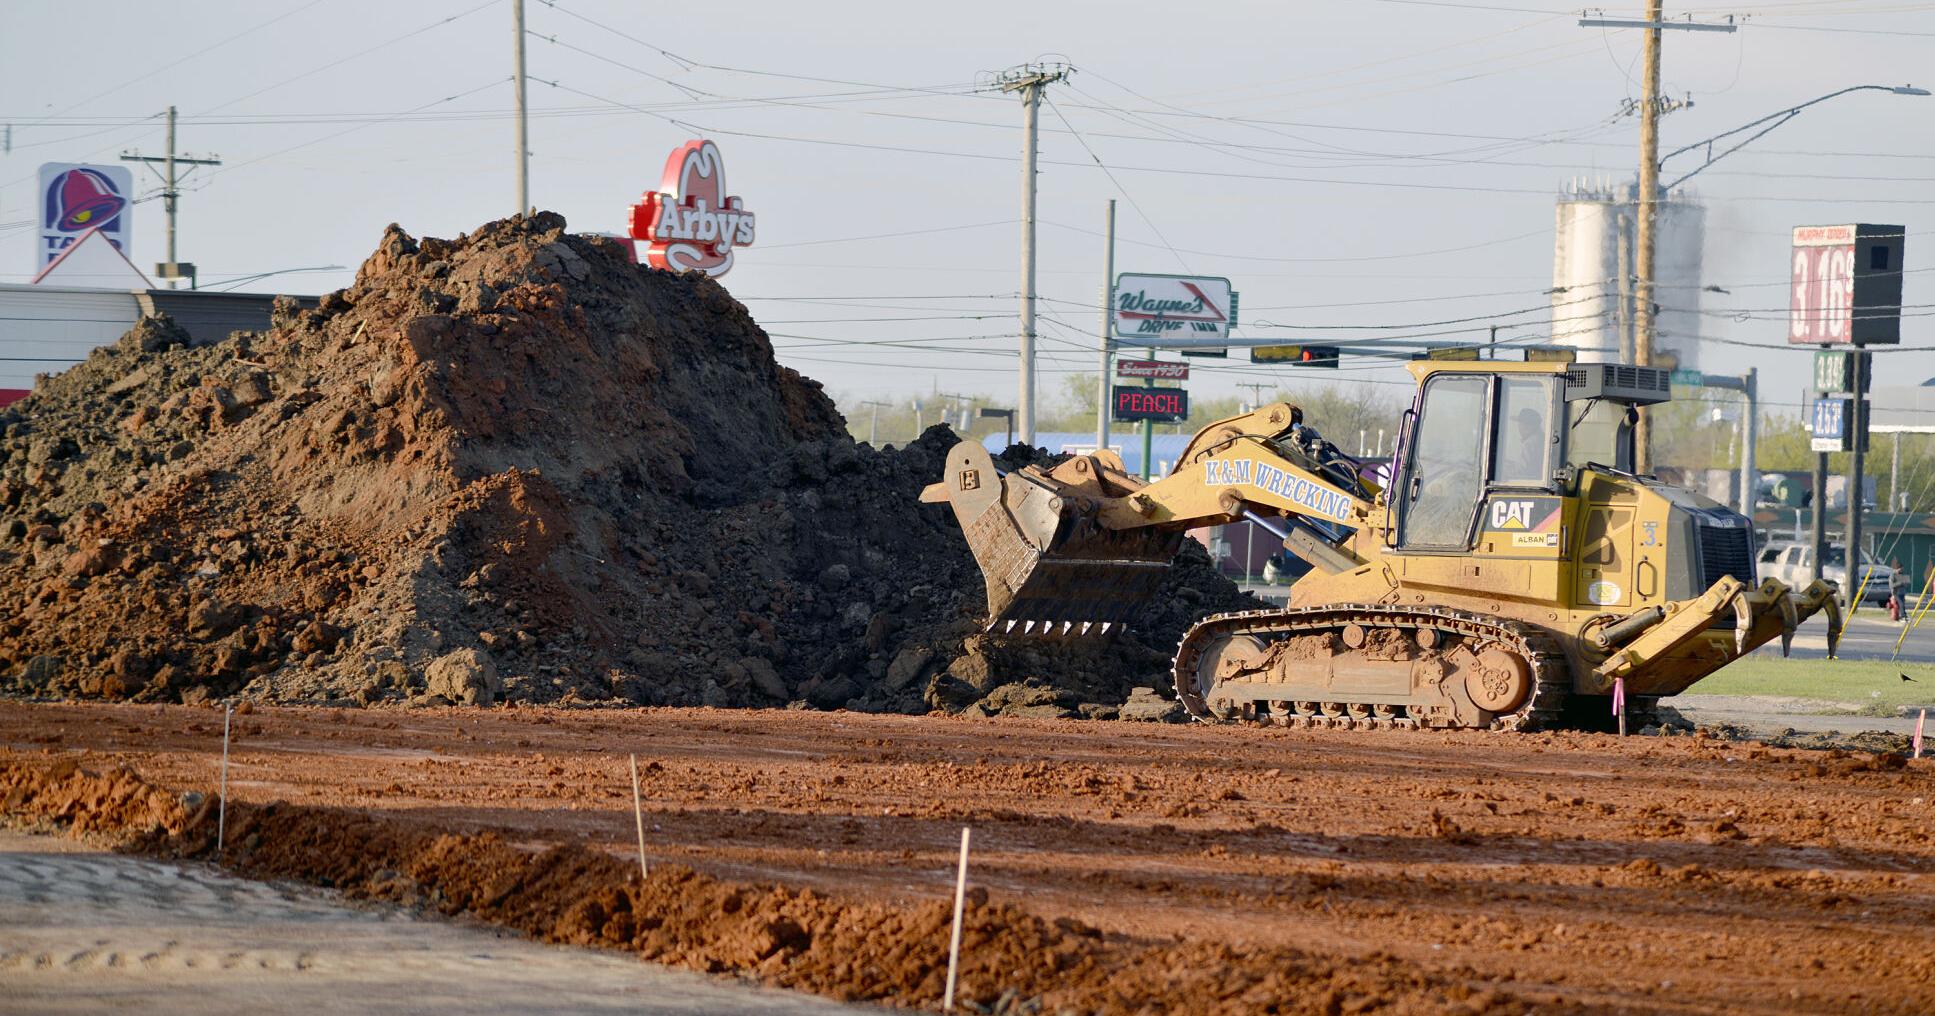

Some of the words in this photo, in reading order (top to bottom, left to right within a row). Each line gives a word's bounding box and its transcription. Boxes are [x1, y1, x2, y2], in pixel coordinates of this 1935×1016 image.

[1137, 320, 1185, 333] DRIVE
[1254, 462, 1352, 521] WRECKING
[1491, 500, 1535, 529] CAT
[1644, 527, 1656, 546] 3
